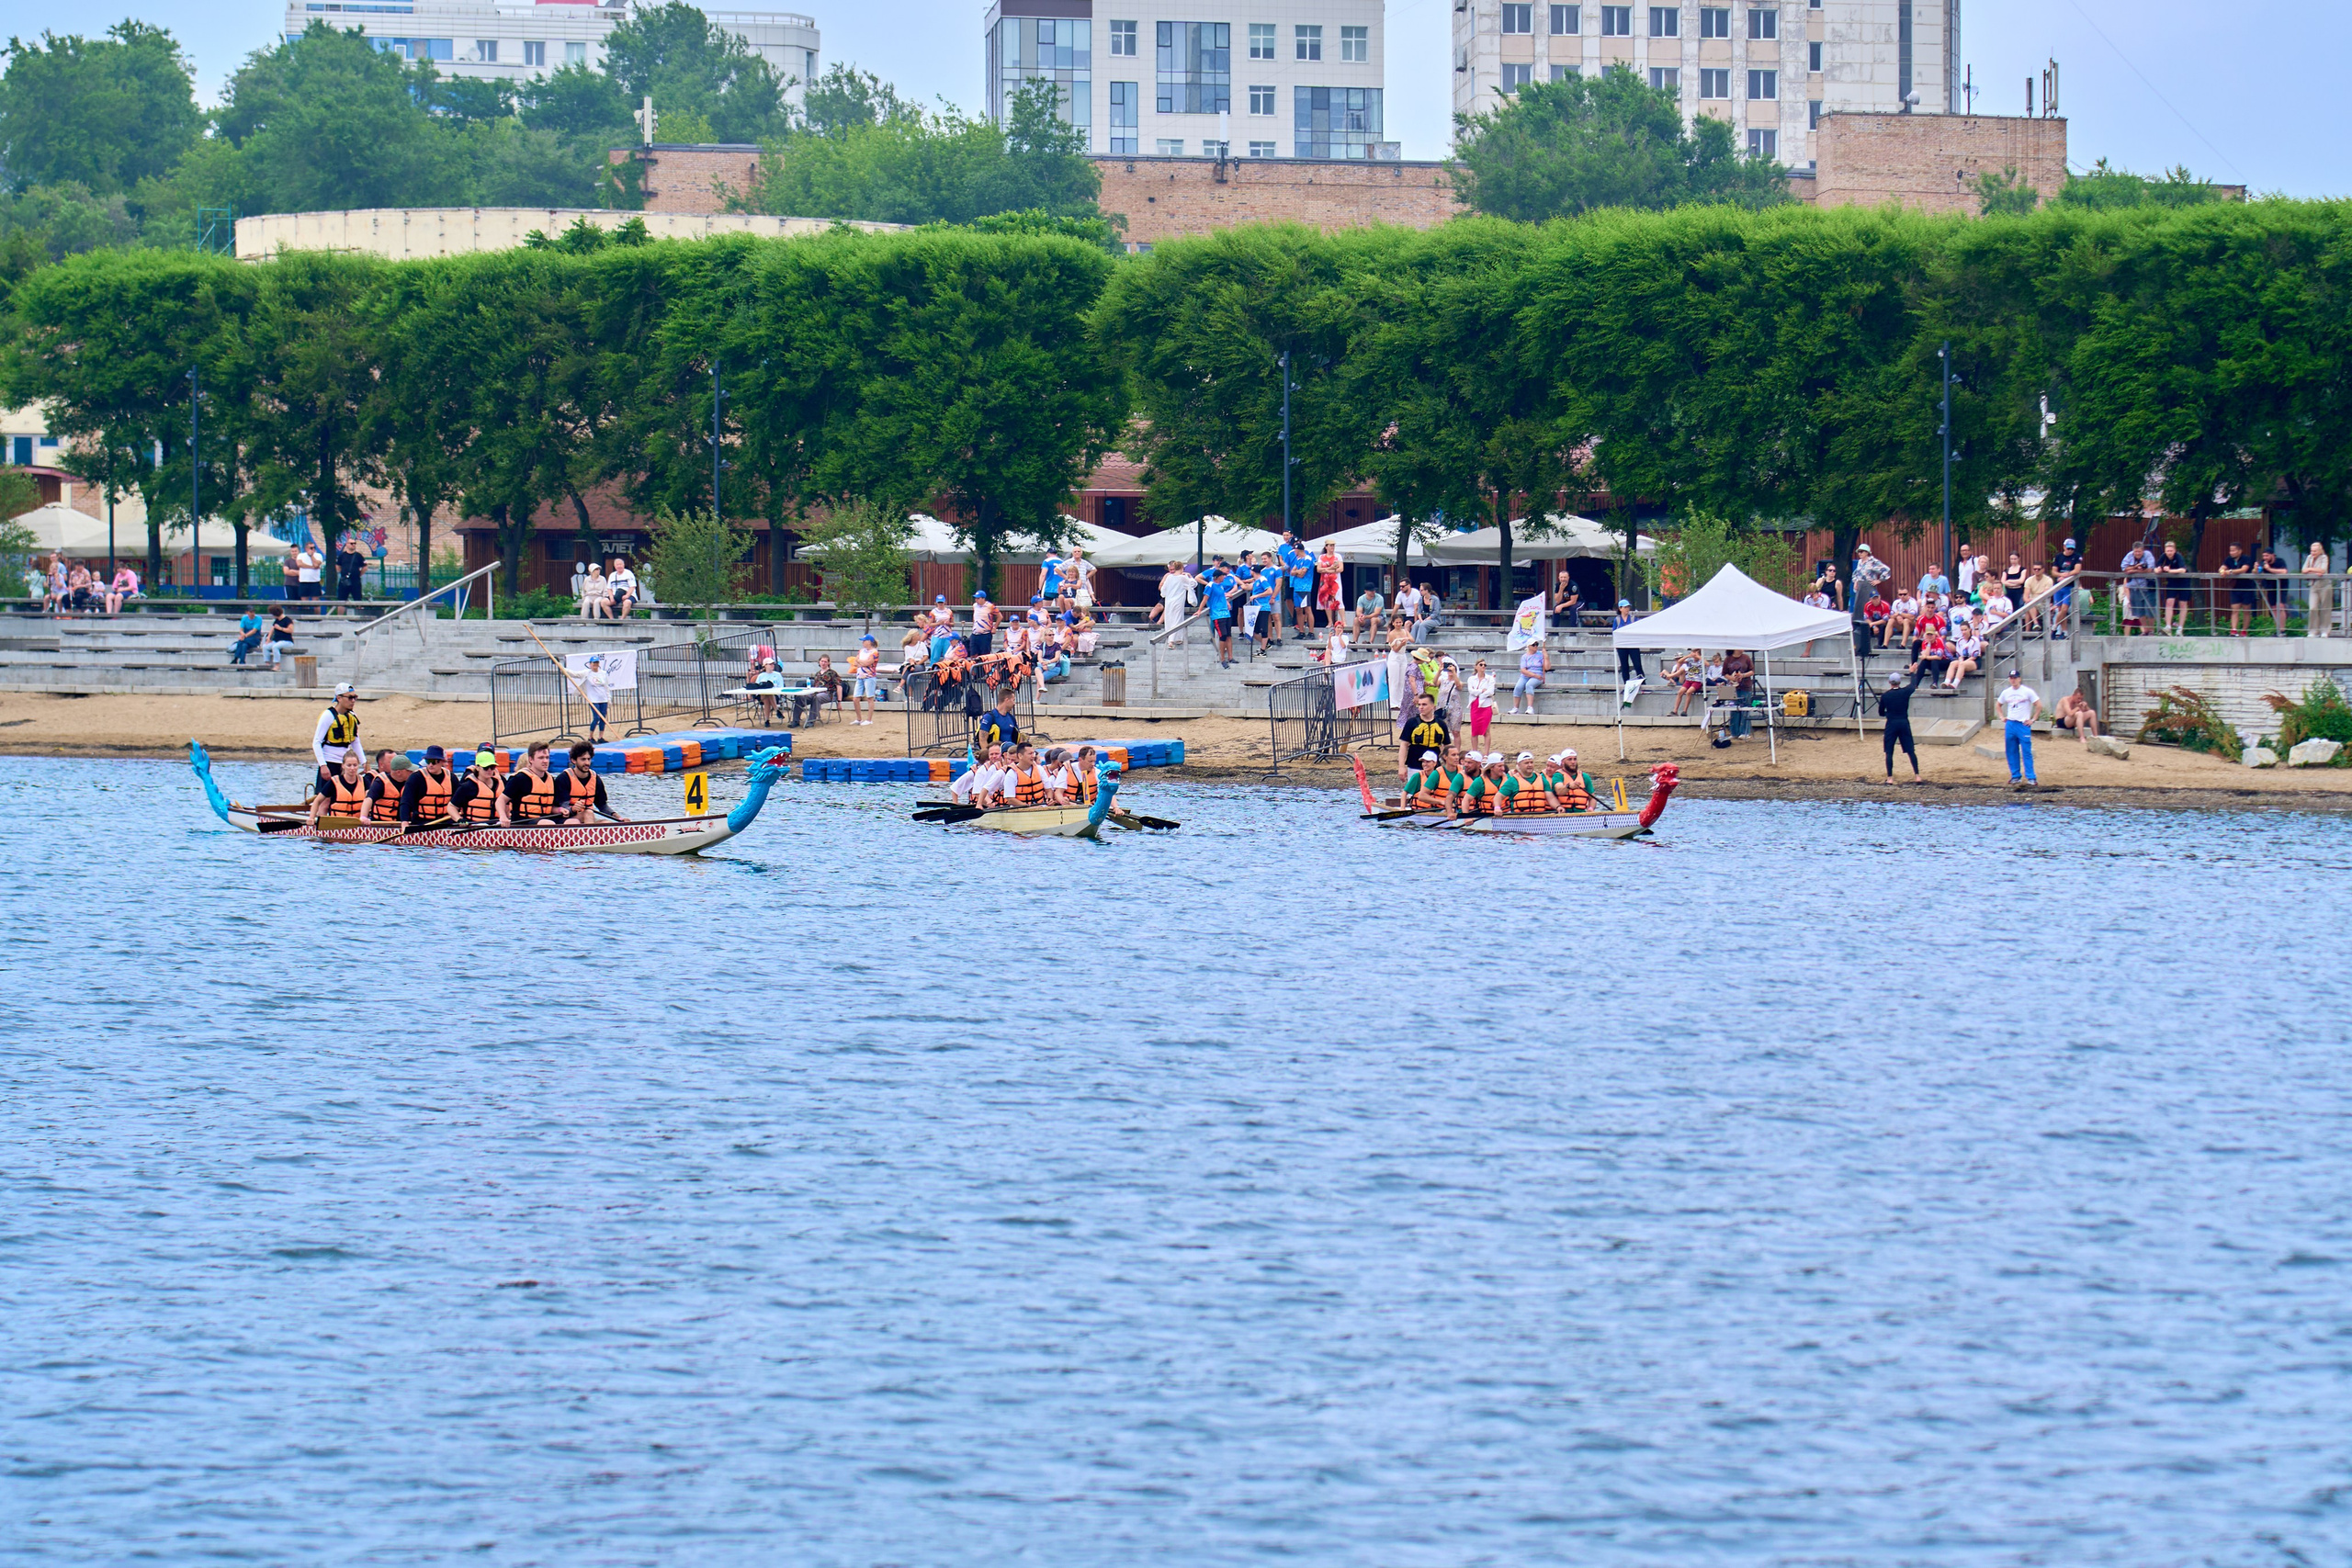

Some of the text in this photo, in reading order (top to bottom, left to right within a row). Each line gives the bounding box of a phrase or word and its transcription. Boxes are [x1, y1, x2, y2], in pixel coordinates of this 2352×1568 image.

[601, 543, 635, 554] АЛЕТ
[687, 775, 703, 809] 4
[1613, 780, 1623, 806] 1
